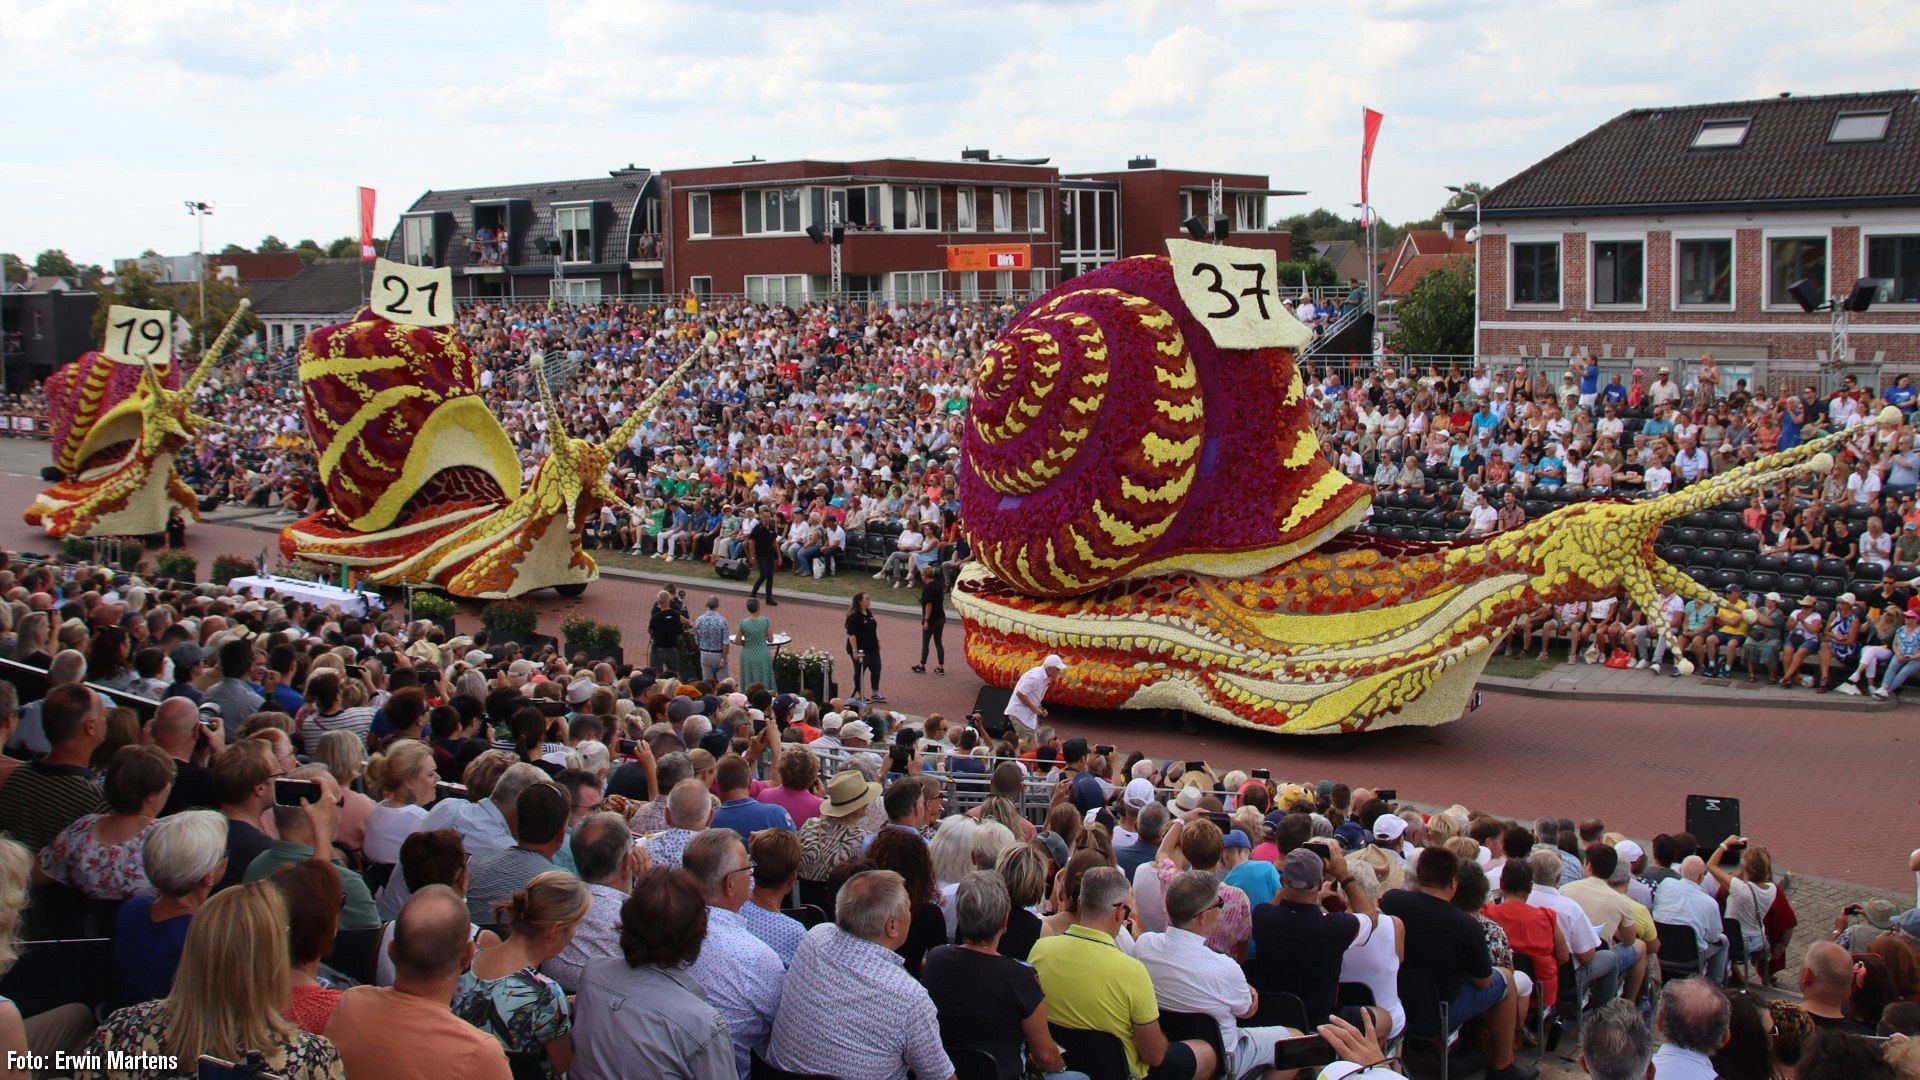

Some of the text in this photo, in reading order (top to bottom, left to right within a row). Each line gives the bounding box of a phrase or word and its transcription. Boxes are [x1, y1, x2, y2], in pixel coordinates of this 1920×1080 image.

[997, 254, 1015, 266] Dirk
[383, 275, 438, 317] 21
[1192, 263, 1270, 319] 37
[114, 318, 164, 355] 19
